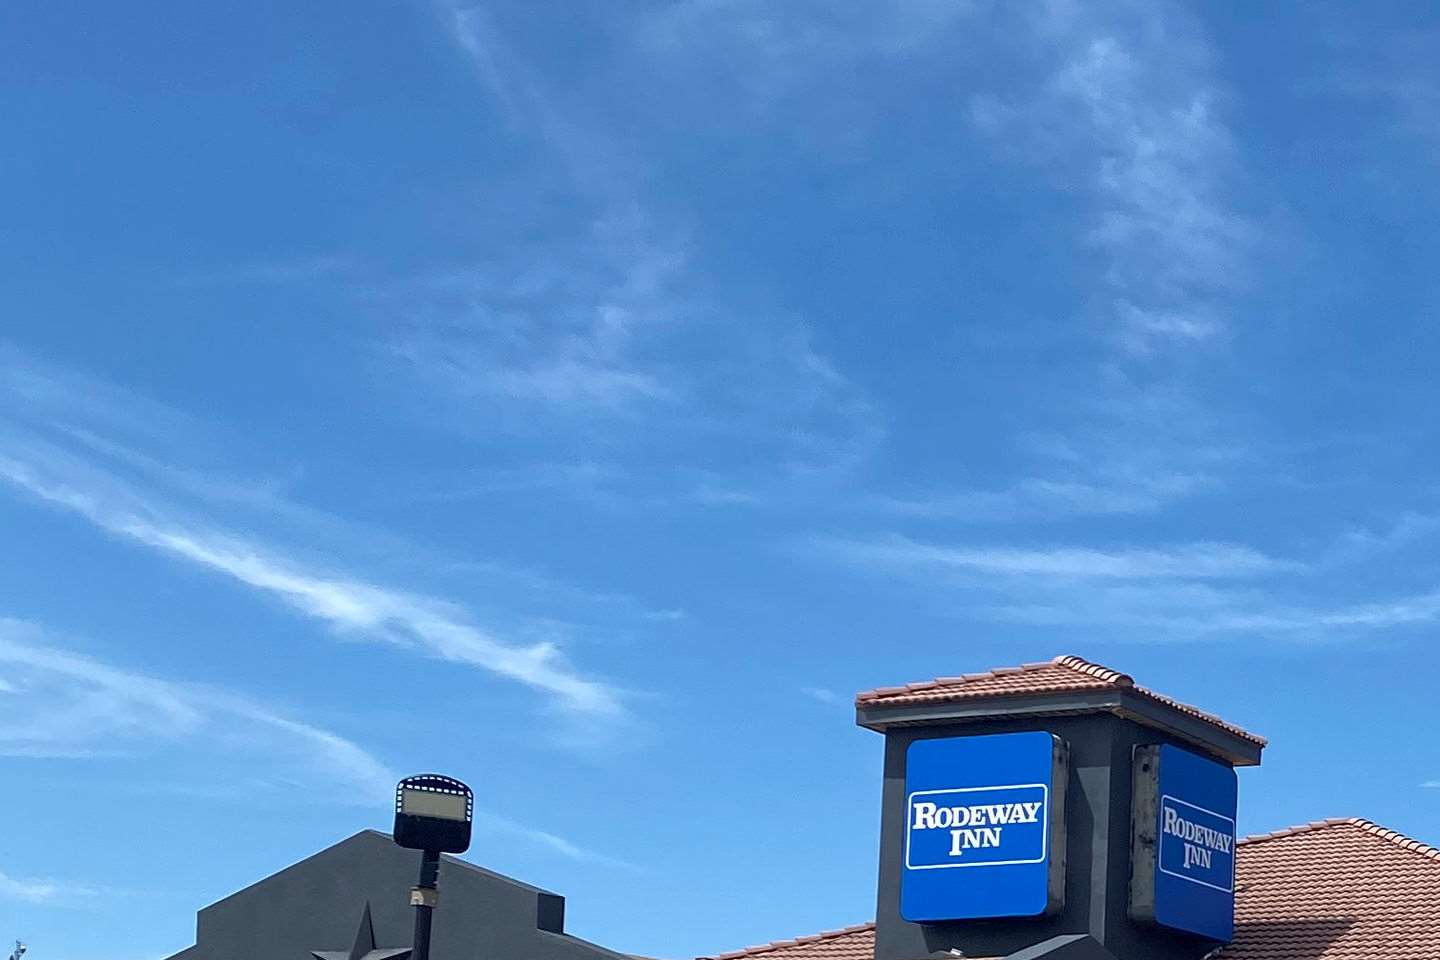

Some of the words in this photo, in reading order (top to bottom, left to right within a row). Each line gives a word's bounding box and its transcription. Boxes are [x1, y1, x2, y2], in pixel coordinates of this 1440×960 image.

[912, 802, 1042, 829] RODEWAY
[949, 827, 1002, 856] INN
[1164, 806, 1232, 854] RODEWAY
[1183, 842, 1212, 869] INN
